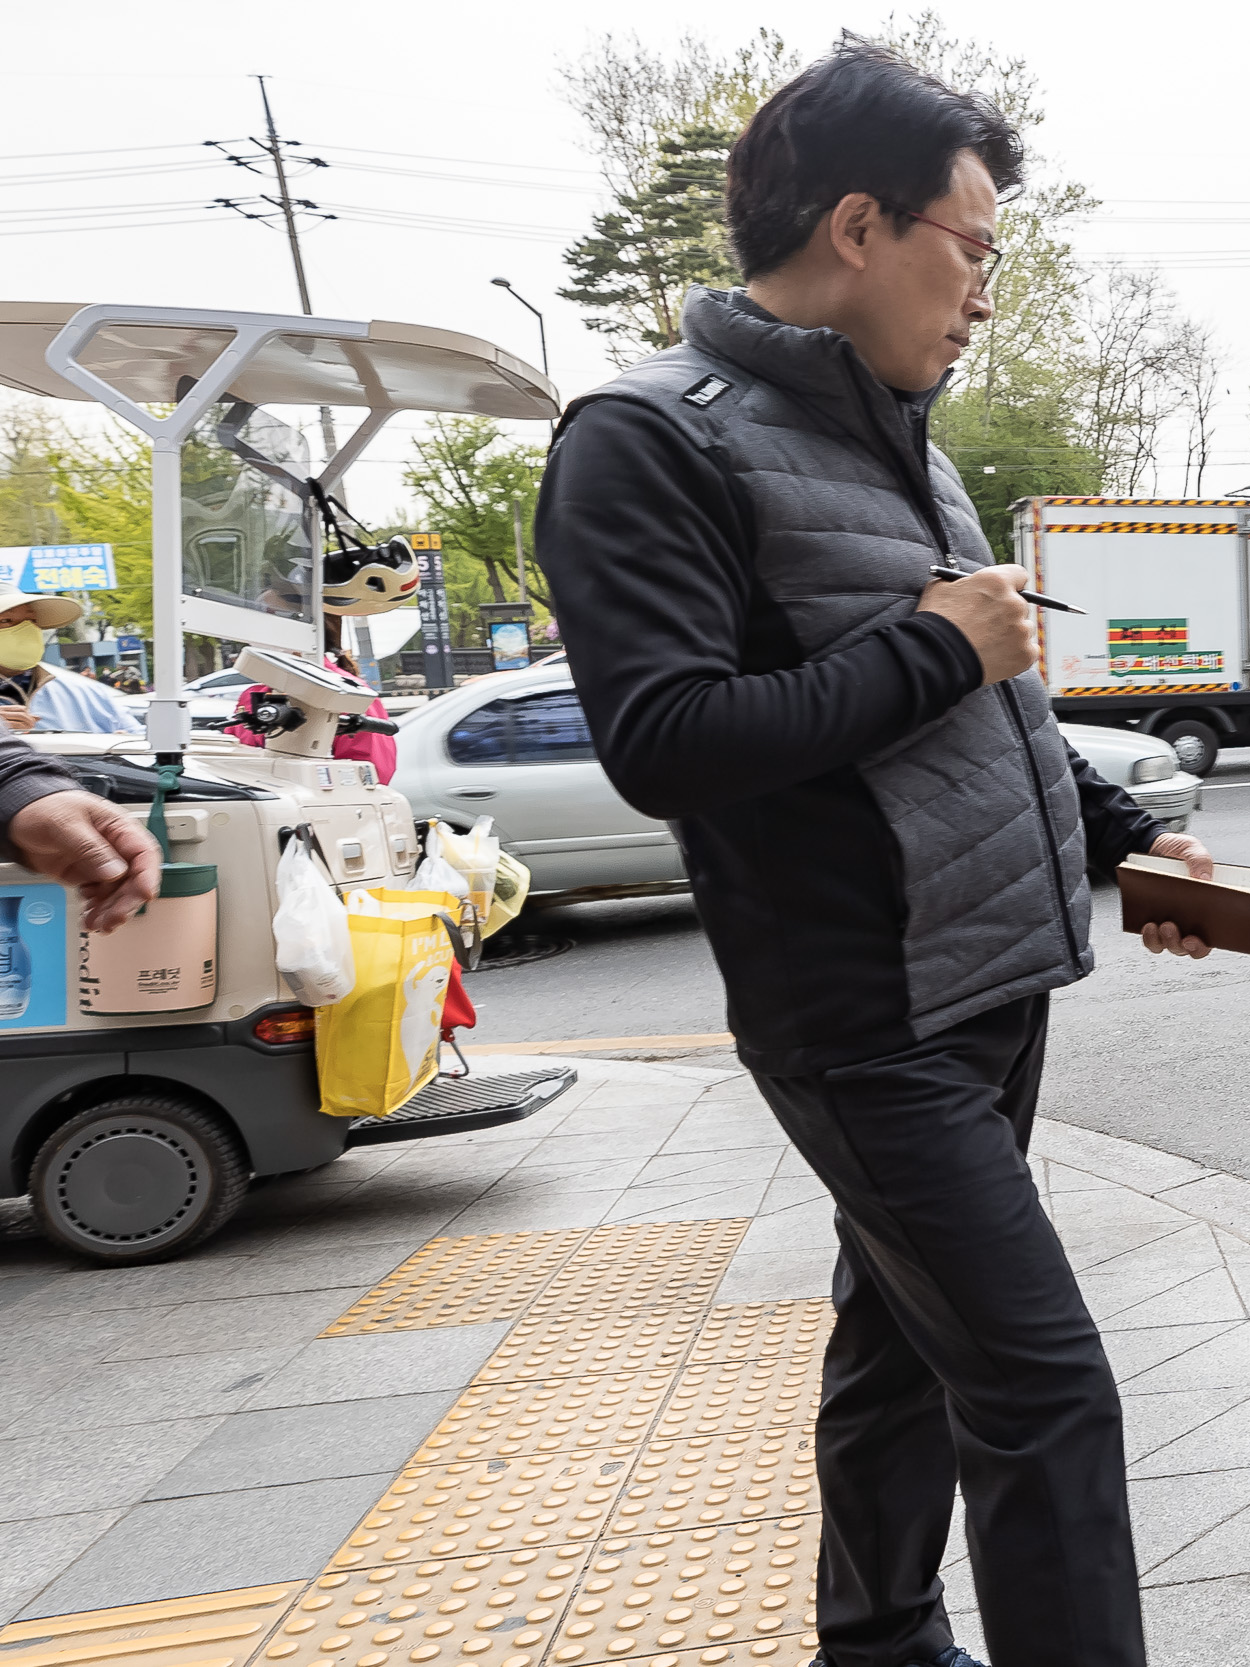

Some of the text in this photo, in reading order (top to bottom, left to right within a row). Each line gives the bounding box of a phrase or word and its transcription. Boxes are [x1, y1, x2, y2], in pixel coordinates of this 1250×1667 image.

[34, 566, 107, 589] 전혜숙
[438, 930, 452, 947] L
[138, 966, 181, 981] 프레딧
